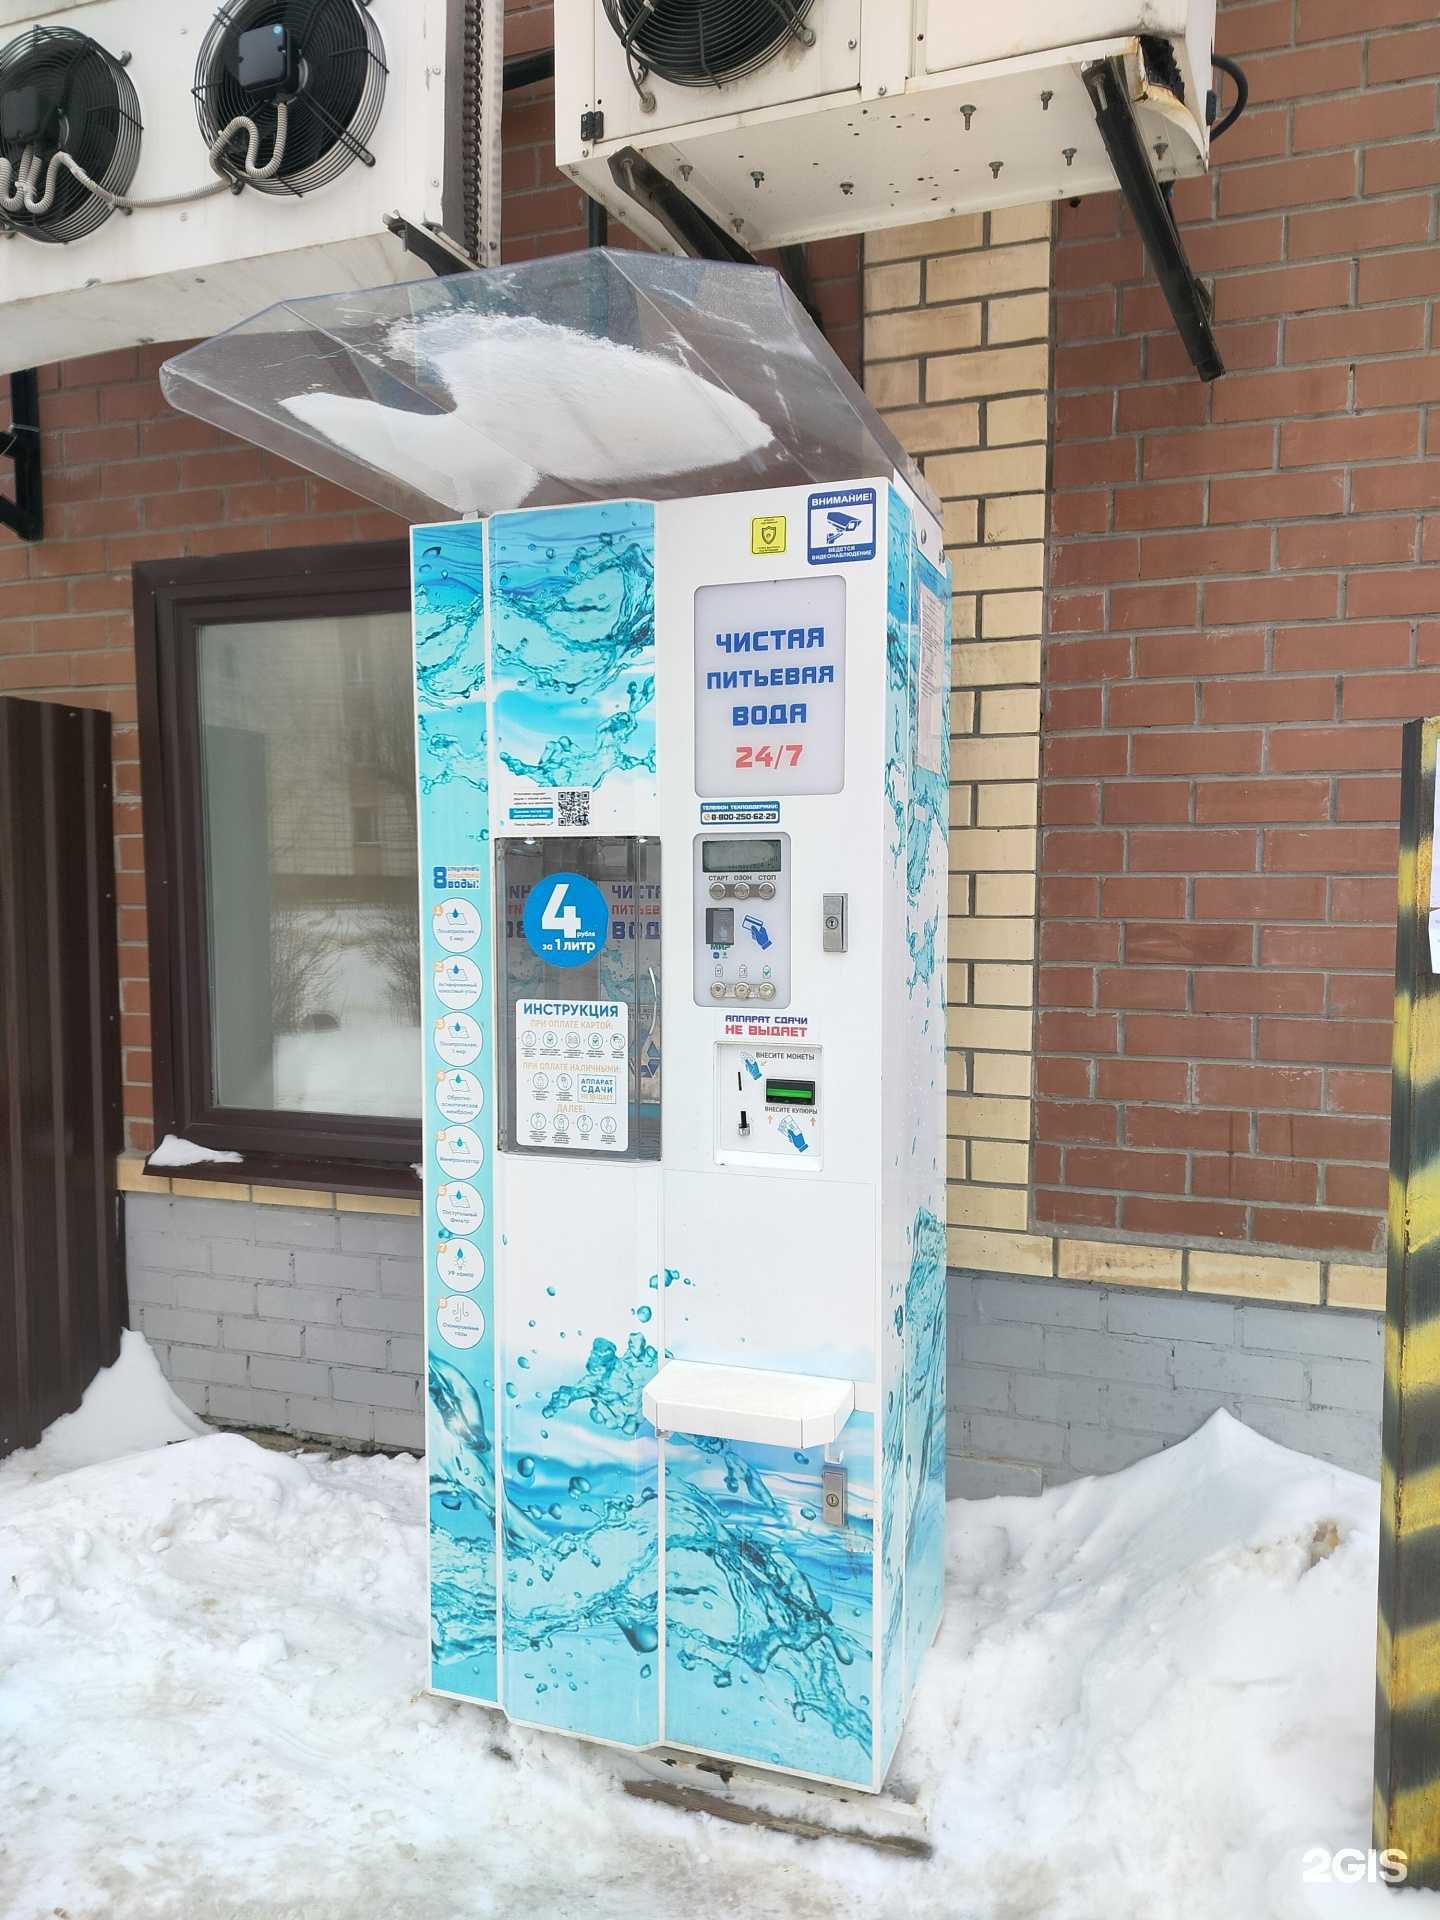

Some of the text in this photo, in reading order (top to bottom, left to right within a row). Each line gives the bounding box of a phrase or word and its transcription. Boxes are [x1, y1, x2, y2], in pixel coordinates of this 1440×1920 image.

[811, 492, 873, 507] ВНИМАНИЕ!
[812, 550, 872, 560] ВИДЕОНАБЛЮДЕНИЕ
[716, 627, 825, 653] ЧИСТАЯ
[706, 665, 834, 690] ПИТЬЕВАЯ
[732, 703, 807, 726] ВОДА
[736, 744, 803, 770] 24/7
[711, 812, 777, 821] 8-800-250-62-29
[433, 866, 447, 888] 8
[541, 883, 582, 938] 4
[555, 939, 561, 950] 1
[564, 941, 596, 954] литр
[523, 1003, 619, 1018] ИНСТРУКЦИЯ
[548, 1019, 580, 1028] ОПЛАТЕ
[725, 1015, 808, 1025] АППАРАТ СДАЧИ
[725, 1024, 808, 1037] НЕ ВЫДАЕТ
[755, 1052, 815, 1061] ВНЕСИТЕ МОНЕТЫ
[581, 1085, 613, 1094] СДАЧИ
[764, 1106, 818, 1115] ВНЕСИТЕ КУПЮРЫ
